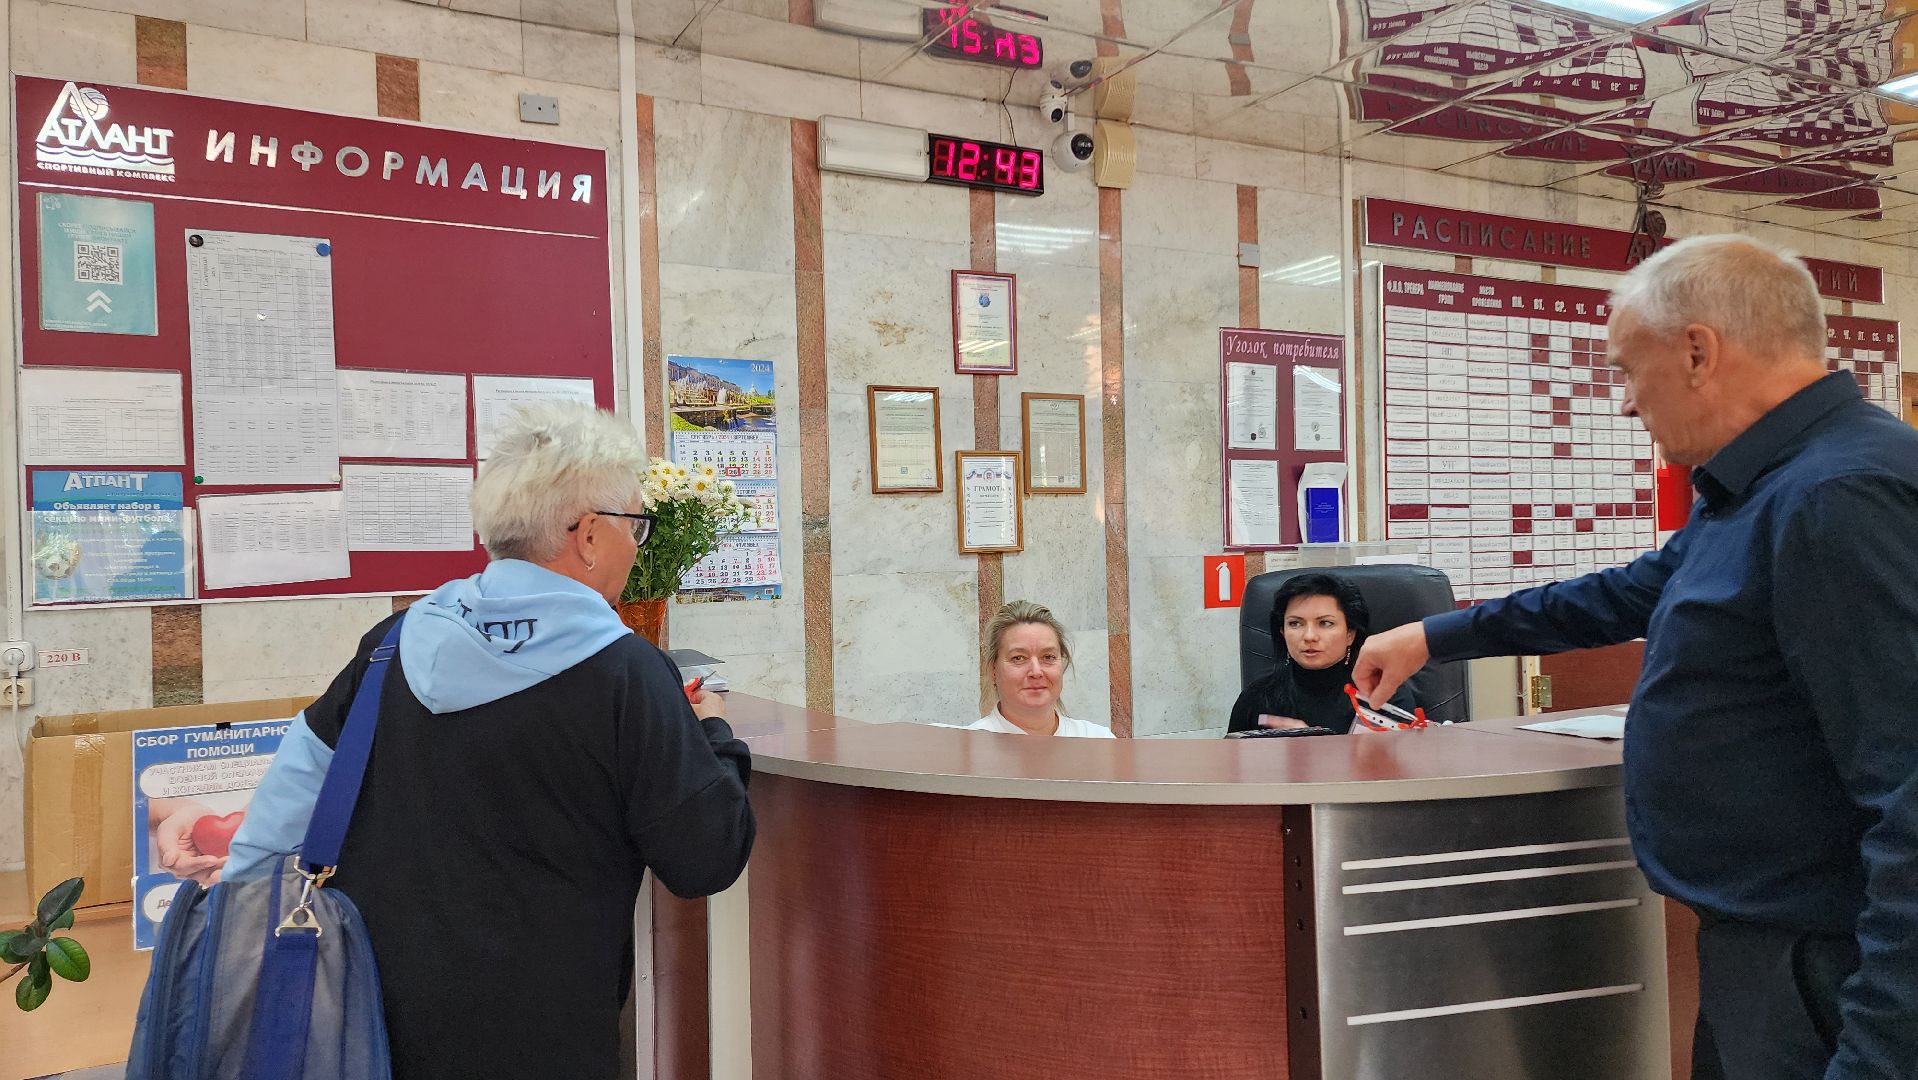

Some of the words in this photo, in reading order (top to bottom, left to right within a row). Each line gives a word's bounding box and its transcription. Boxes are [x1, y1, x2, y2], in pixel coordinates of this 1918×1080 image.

[36, 81, 175, 156] АТЛАНТ
[37, 162, 115, 177] СПОРТИВНЫЙ
[116, 170, 176, 182] КОМПЛЕКС
[205, 129, 592, 204] ИНФОРМАЦИЯ
[944, 141, 1041, 189] 12:43
[1393, 211, 1591, 259] РАСПИСАНИЕ
[1226, 334, 1268, 359] Уголок
[1273, 338, 1340, 362] потребителя
[751, 362, 771, 373] 2024
[53, 502, 116, 510] Объявляет
[117, 502, 152, 512] набор
[43, 515, 85, 525] секцию
[47, 653, 68, 664] 220
[72, 651, 81, 662] В
[136, 734, 179, 748] СБОР
[184, 725, 290, 744] ГУМАНИТАРНО
[186, 743, 255, 759] ПОМОЩИ
[149, 763, 216, 778] УЧАСТНИКАМ
[169, 772, 218, 785] ВОЕННОЙ
[221, 770, 265, 780] ОПЕРАЦИ
[162, 786, 170, 796] И
[157, 899, 170, 908] Де
